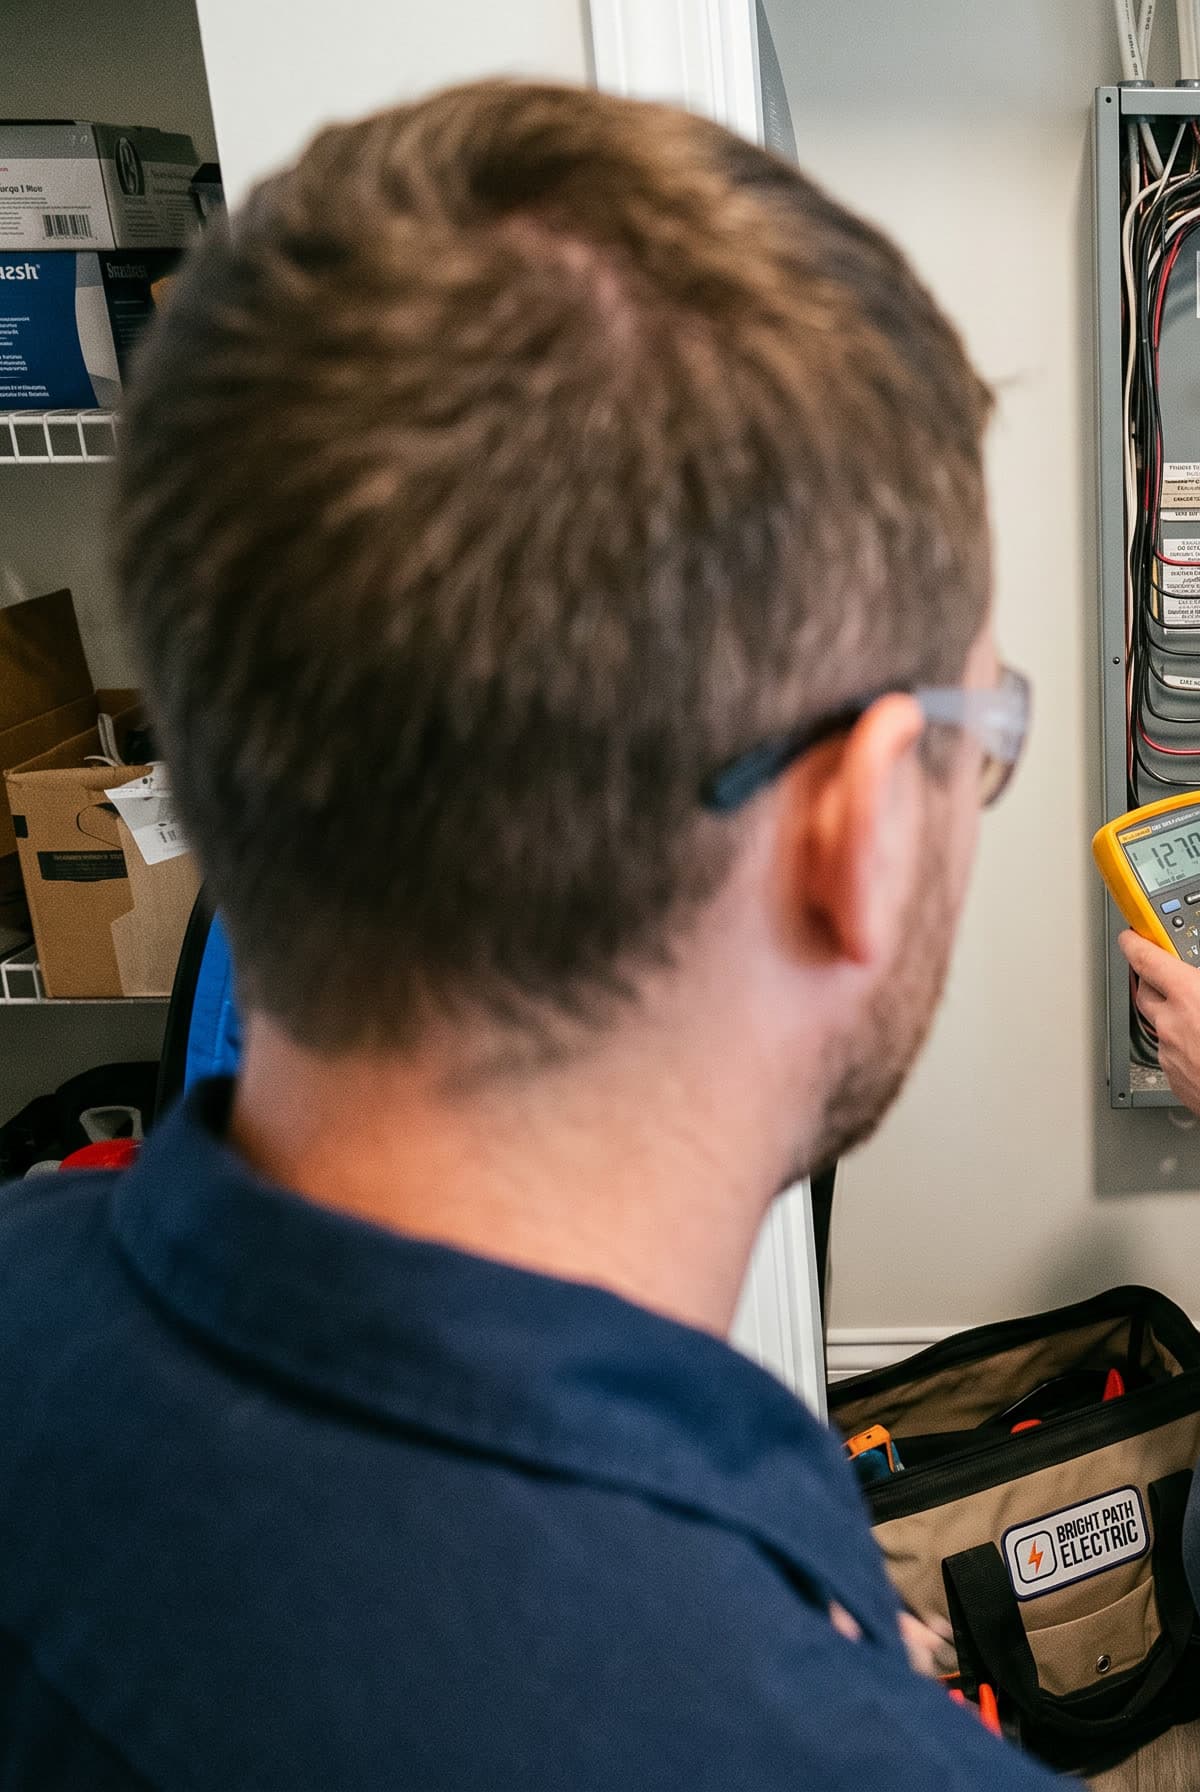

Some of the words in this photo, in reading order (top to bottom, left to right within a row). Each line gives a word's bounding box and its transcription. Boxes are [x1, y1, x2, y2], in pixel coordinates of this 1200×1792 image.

[1056, 1511, 1100, 1544] BRIGHT
[1101, 1500, 1135, 1526] PATH
[1060, 1519, 1139, 1569] ELECTRIC
